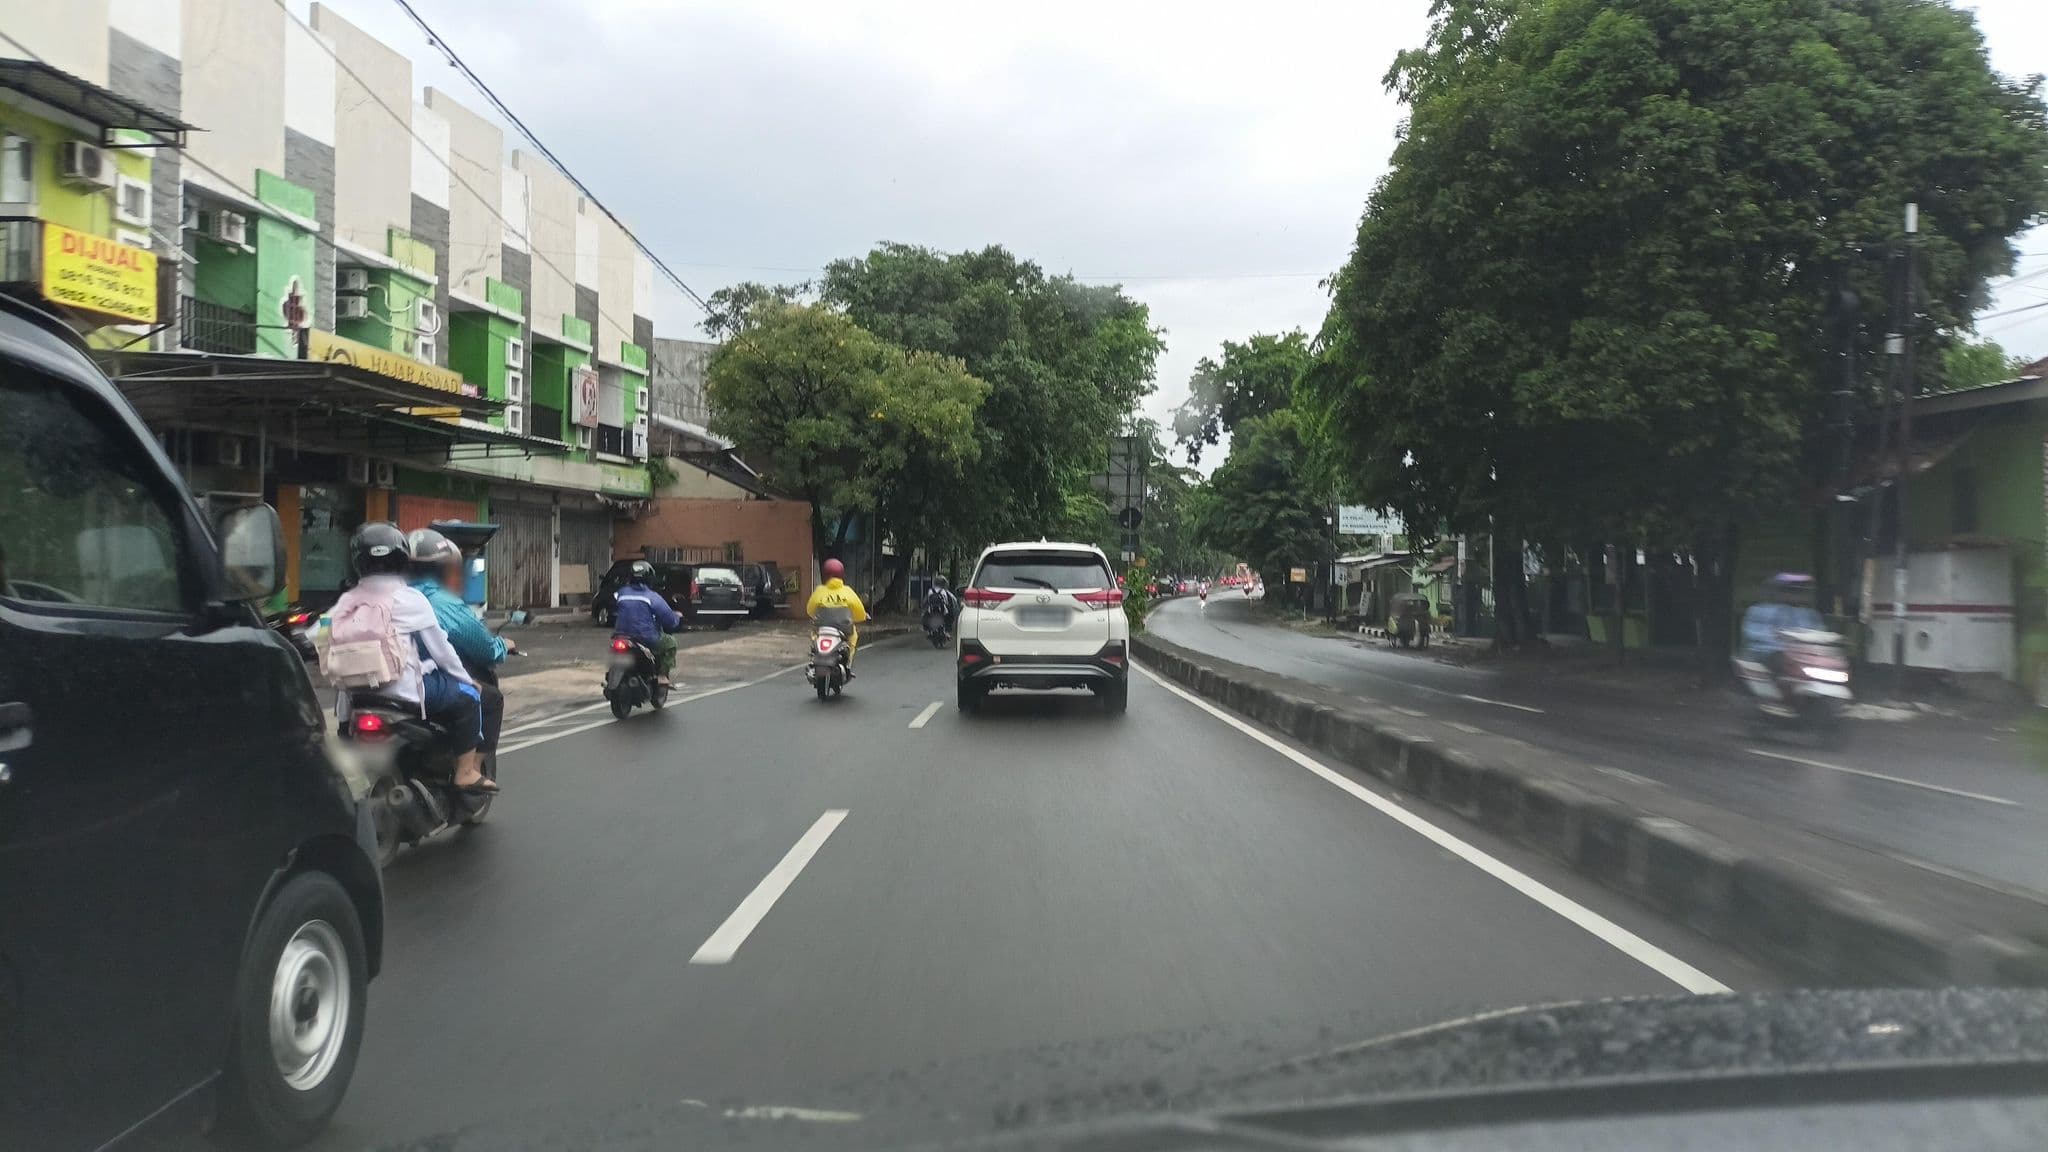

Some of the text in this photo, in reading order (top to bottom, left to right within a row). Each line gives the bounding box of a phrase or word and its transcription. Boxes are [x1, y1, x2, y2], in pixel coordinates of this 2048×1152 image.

[62, 231, 144, 273] DIJUAL
[371, 354, 416, 382] HAJAR
[418, 370, 459, 394] ASWAD
